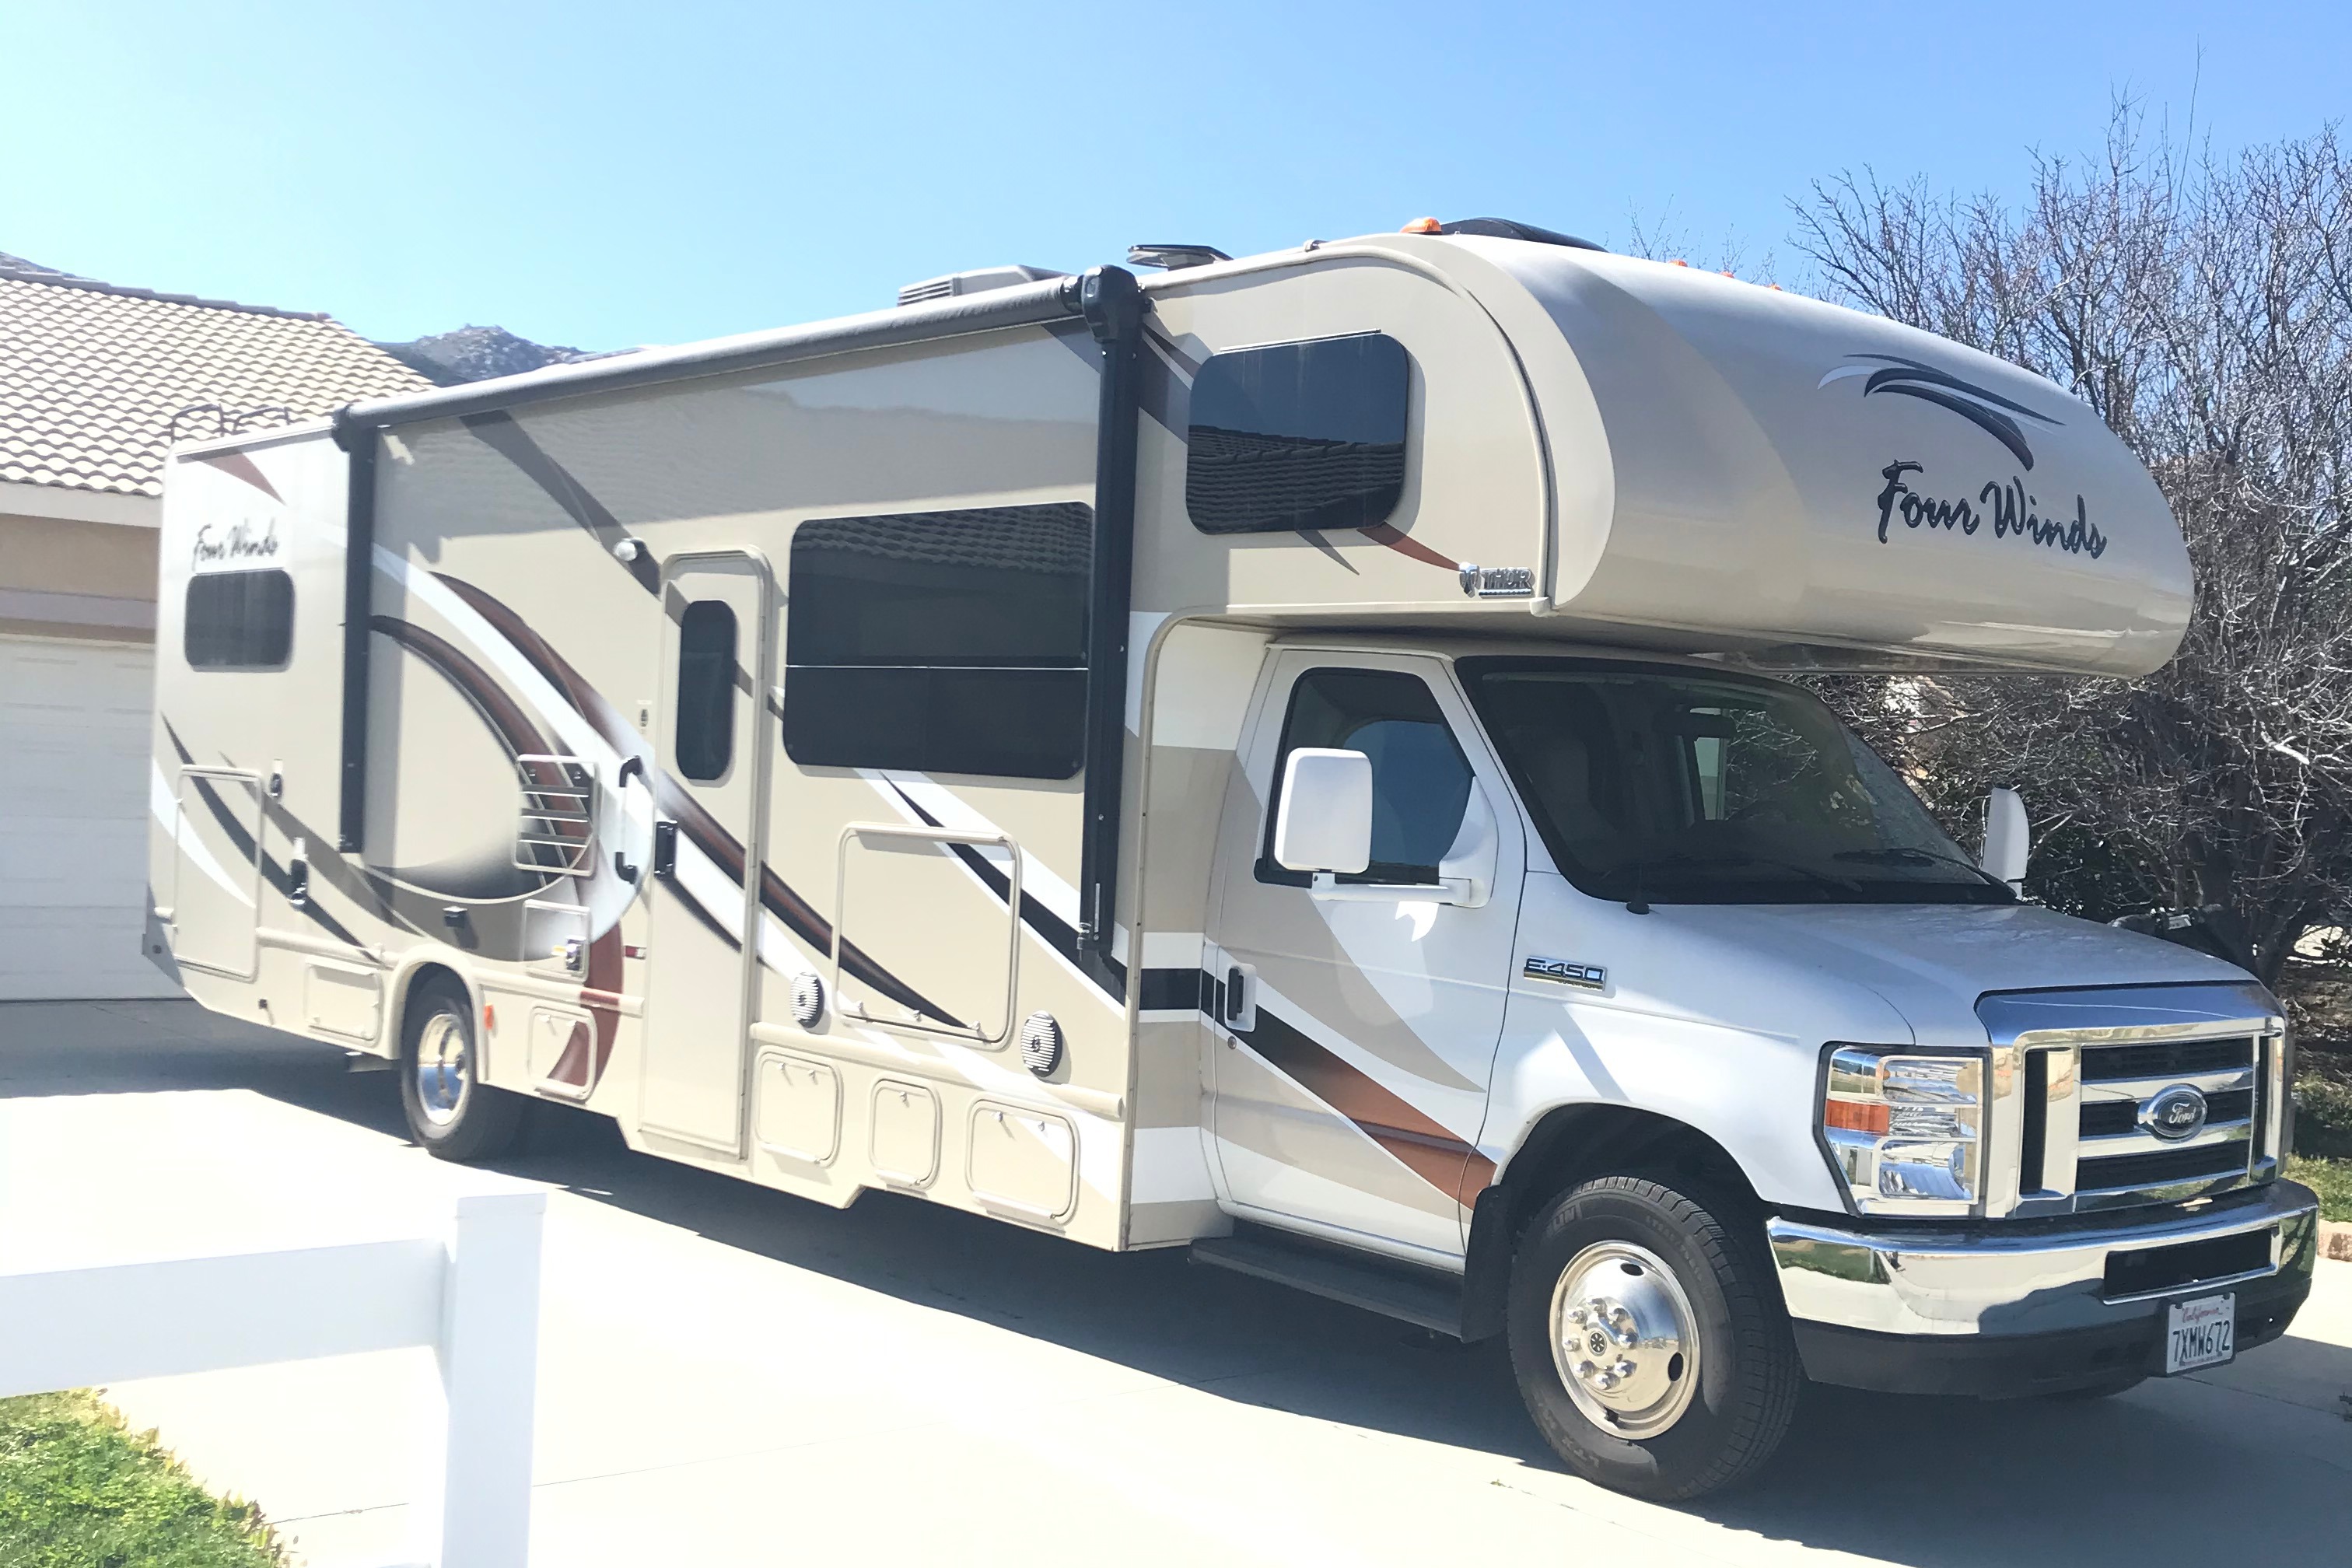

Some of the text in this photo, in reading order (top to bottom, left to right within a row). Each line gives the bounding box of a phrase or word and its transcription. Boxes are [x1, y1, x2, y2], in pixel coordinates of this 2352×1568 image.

[1878, 459, 2108, 560] Four Winds
[1480, 568, 1531, 590] THOR
[2168, 1102, 2197, 1125] Ford
[2172, 1319, 2231, 1363] 7XMW672
